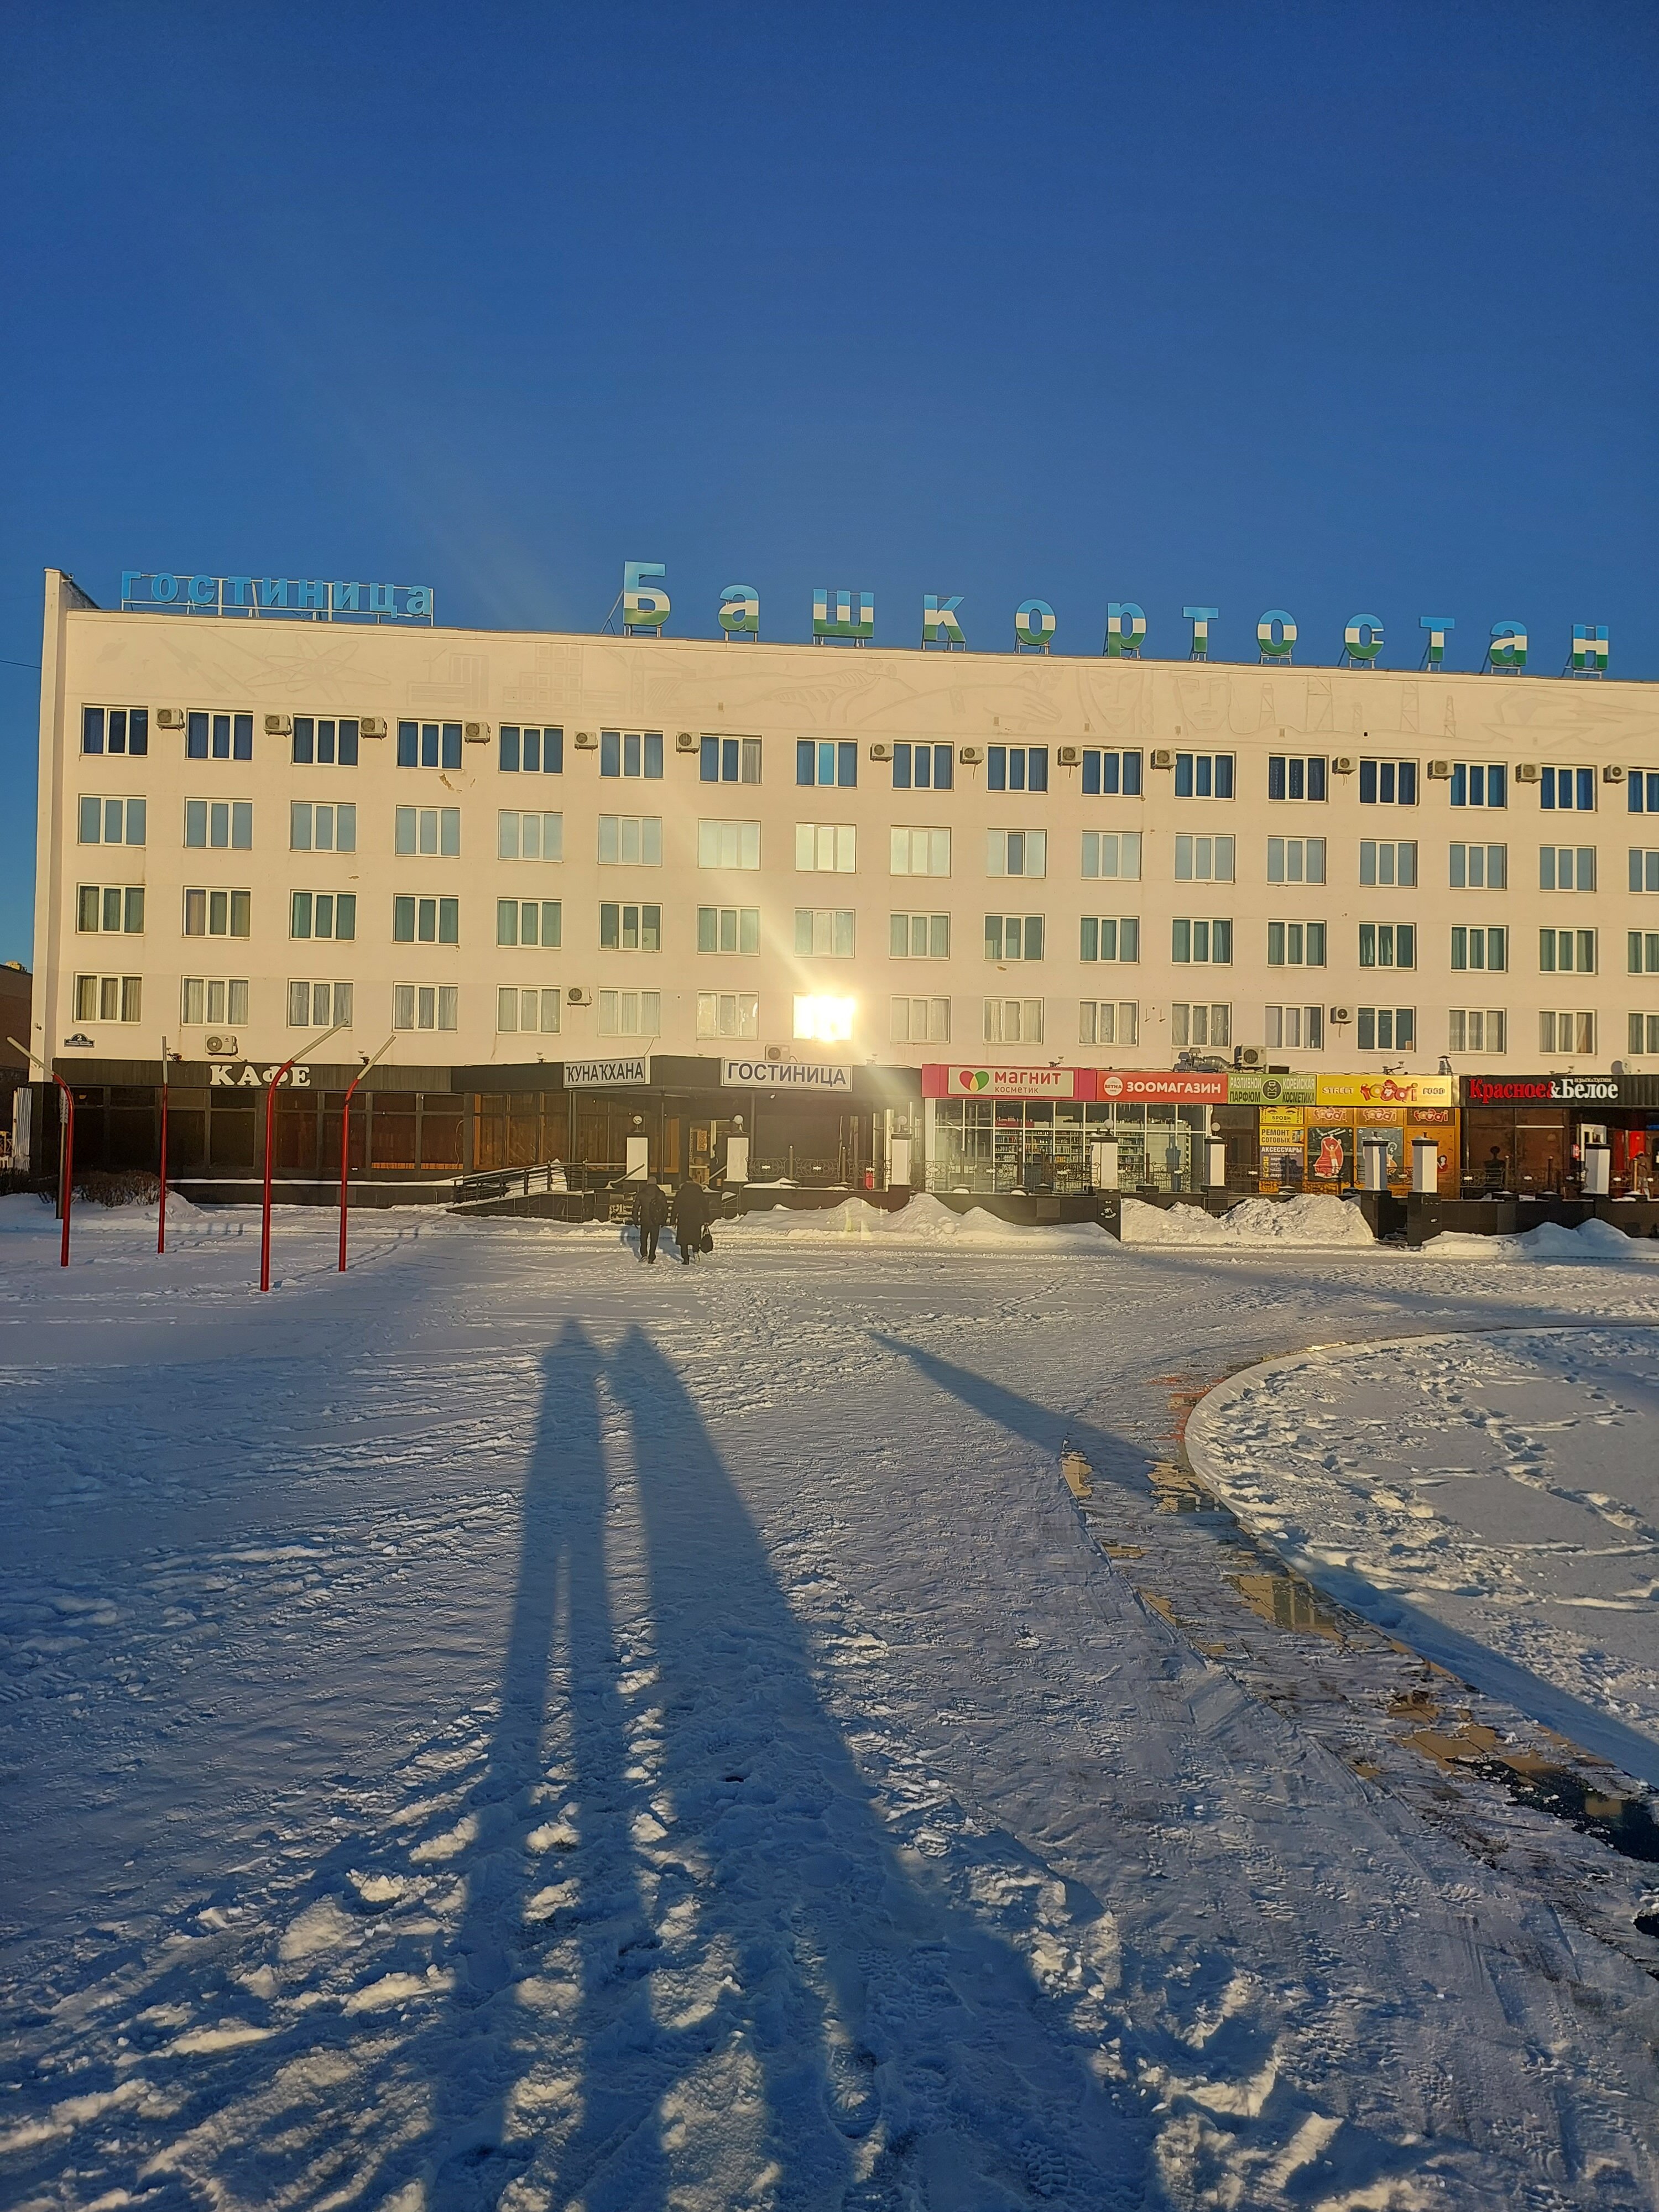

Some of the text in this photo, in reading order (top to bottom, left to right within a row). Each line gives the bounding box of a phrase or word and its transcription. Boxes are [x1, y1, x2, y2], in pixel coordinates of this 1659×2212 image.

[624, 561, 1609, 670] Башкортостан
[210, 1065, 311, 1087] КАФЕ
[728, 1062, 847, 1087] ГОСТИНИЦА
[1126, 1081, 1221, 1093] ЗООМАГАЗИН
[1230, 1076, 1261, 1089] РАЗЛИВНОЙ
[1282, 1077, 1314, 1089] КОРЕЙСКАЯ
[1229, 1091, 1261, 1102] ПАРФЮМ
[1282, 1092, 1314, 1103] КОСМЕТИКА
